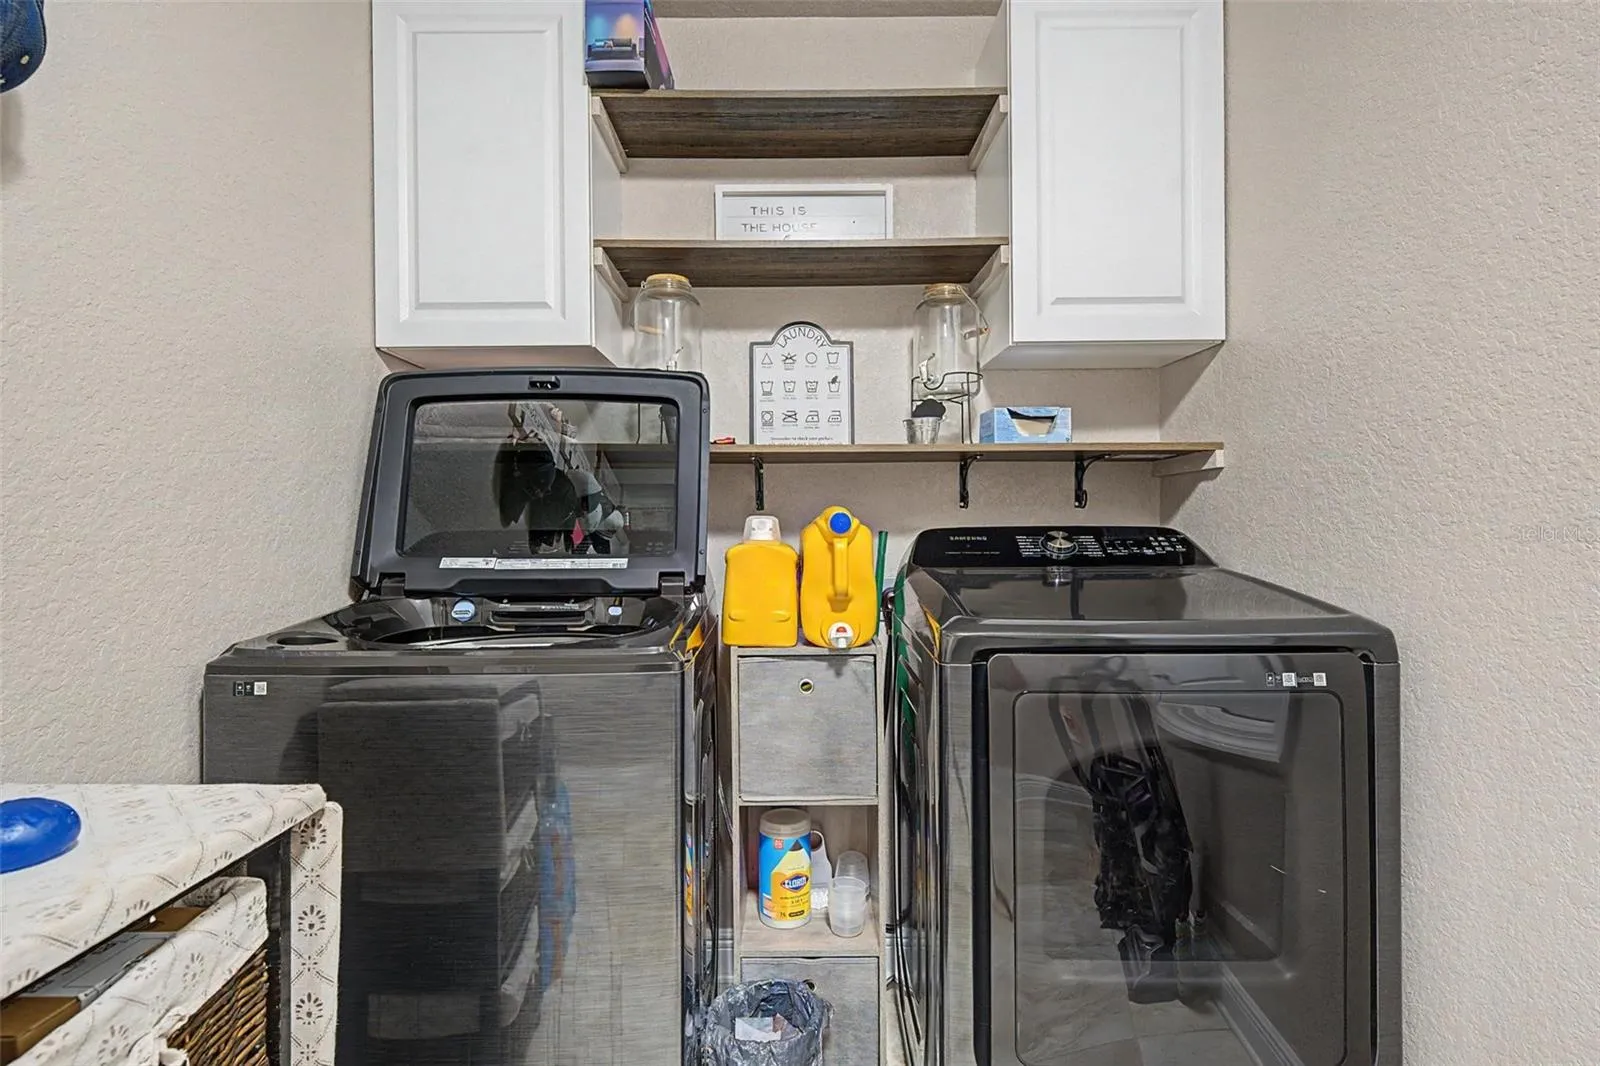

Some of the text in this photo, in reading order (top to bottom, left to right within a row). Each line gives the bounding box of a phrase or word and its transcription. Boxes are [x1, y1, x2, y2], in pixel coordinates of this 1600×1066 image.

[750, 206, 807, 216] THIS IS
[742, 223, 766, 233] THE
[777, 327, 827, 348] LAUNDRY
